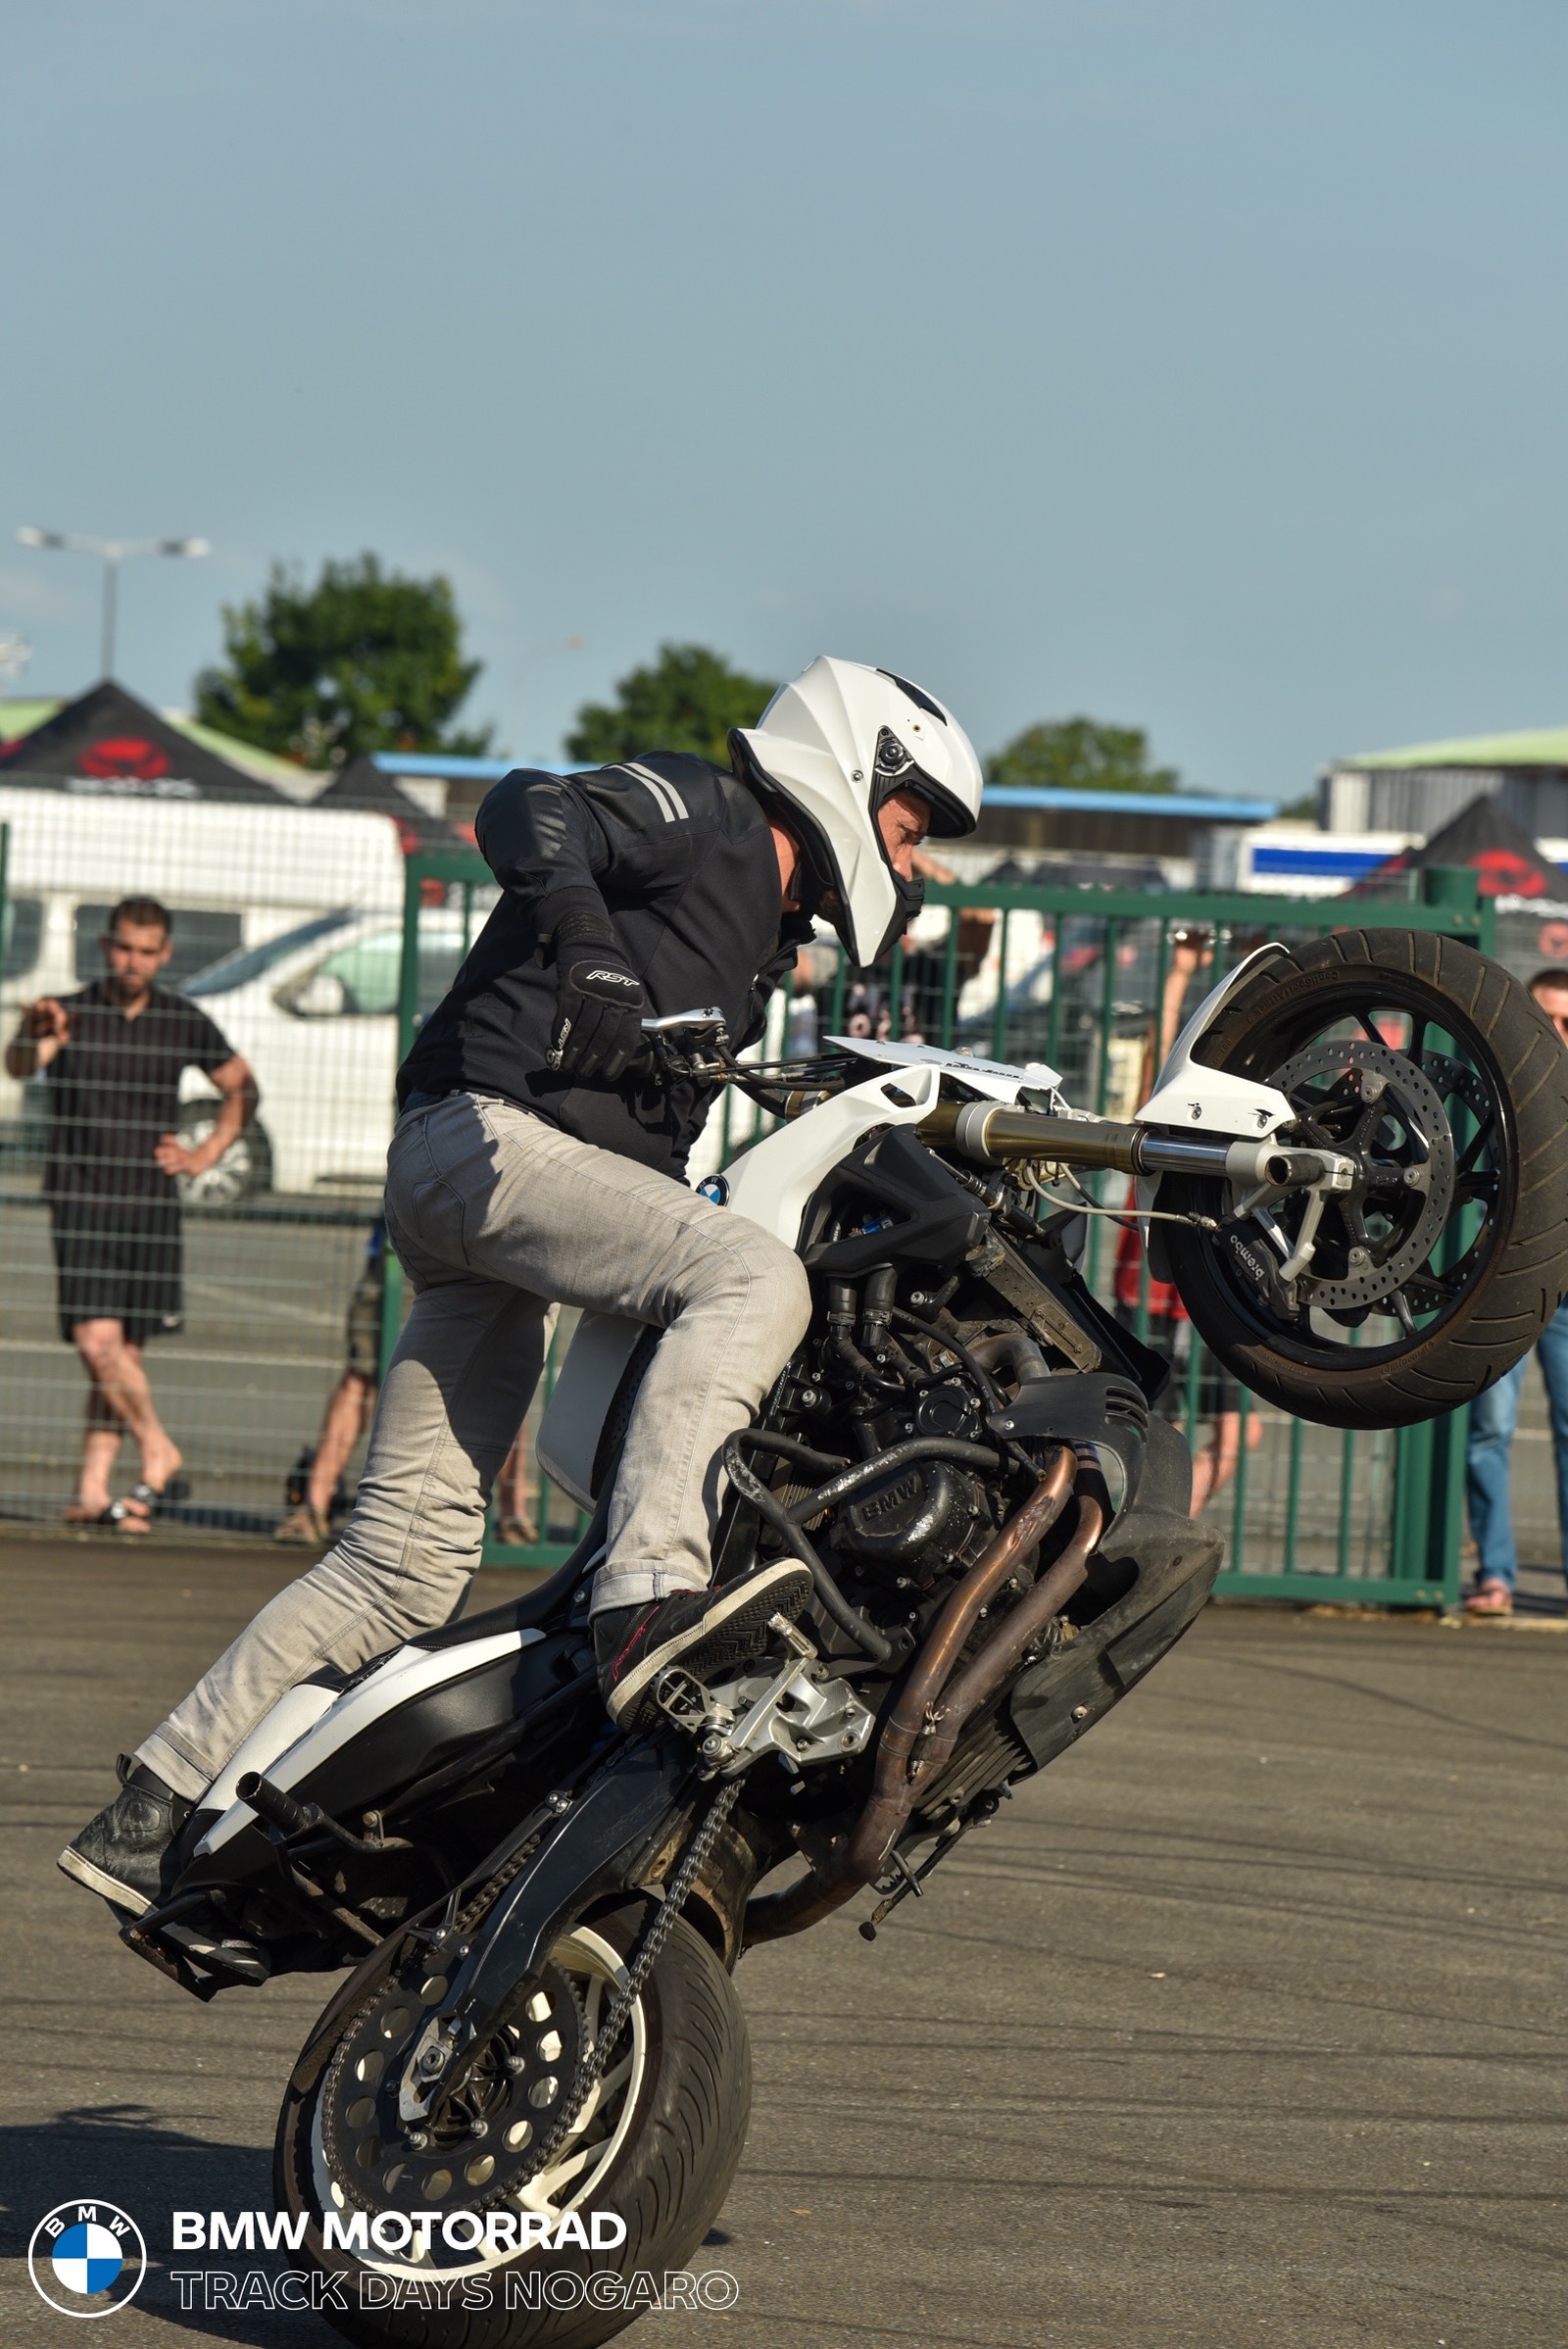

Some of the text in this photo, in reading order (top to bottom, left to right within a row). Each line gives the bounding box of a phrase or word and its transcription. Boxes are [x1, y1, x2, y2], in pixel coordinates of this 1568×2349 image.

[586, 970, 640, 986] RST
[1230, 1235, 1265, 1281] brembo
[862, 1474, 918, 1521] BMW
